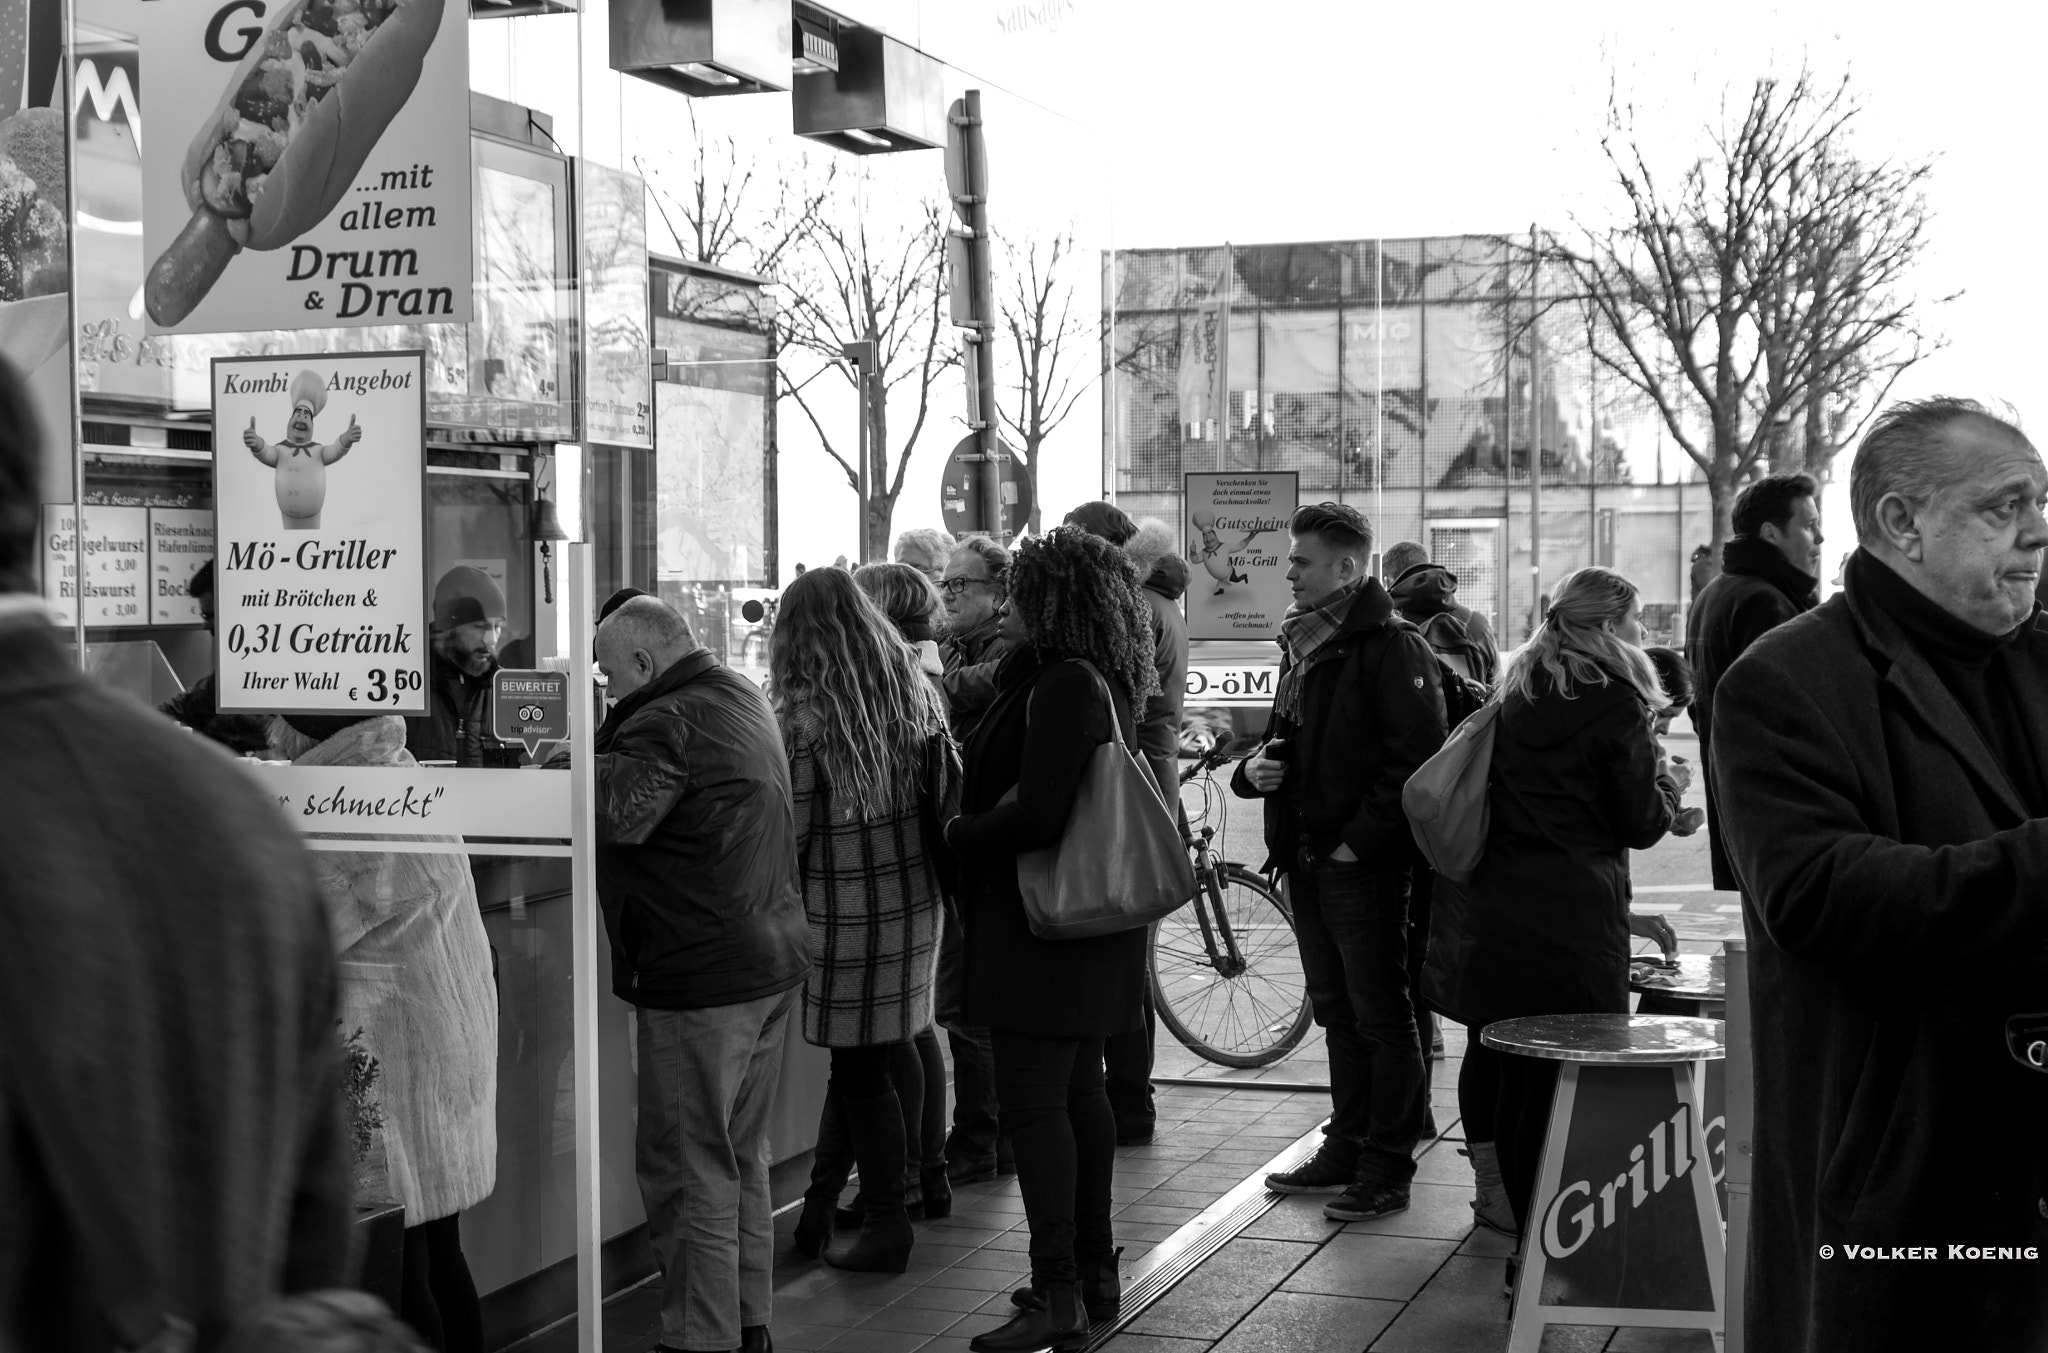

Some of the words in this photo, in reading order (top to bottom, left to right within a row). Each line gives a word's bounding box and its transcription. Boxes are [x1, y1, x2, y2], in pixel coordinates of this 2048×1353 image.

[356, 163, 434, 192] ...mit
[339, 201, 436, 231] allem
[286, 244, 419, 281] Drum
[304, 290, 325, 310] &
[336, 282, 454, 319] Dran
[223, 372, 289, 395] Kombi
[326, 368, 413, 396] Angebot
[1212, 498, 1271, 506] Geschmackvolles!
[1227, 555, 1279, 567] Mö-Grill
[59, 580, 136, 598] Ridswurst
[241, 588, 270, 607] mit
[274, 588, 356, 607] Brötchen
[362, 588, 379, 607] &
[1232, 621, 1273, 629] Geschmack!
[1246, 612, 1265, 620] jeden
[228, 623, 282, 660] 0,3l
[289, 623, 412, 654] Getränk
[242, 671, 289, 690] Ihrer
[294, 671, 340, 690] Wahl
[501, 681, 560, 692] BEWERTET
[348, 687, 358, 701] €
[511, 724, 551, 735] tripadvisor
[303, 785, 445, 818] schmeckt"
[1543, 1105, 1693, 1259] Grill
